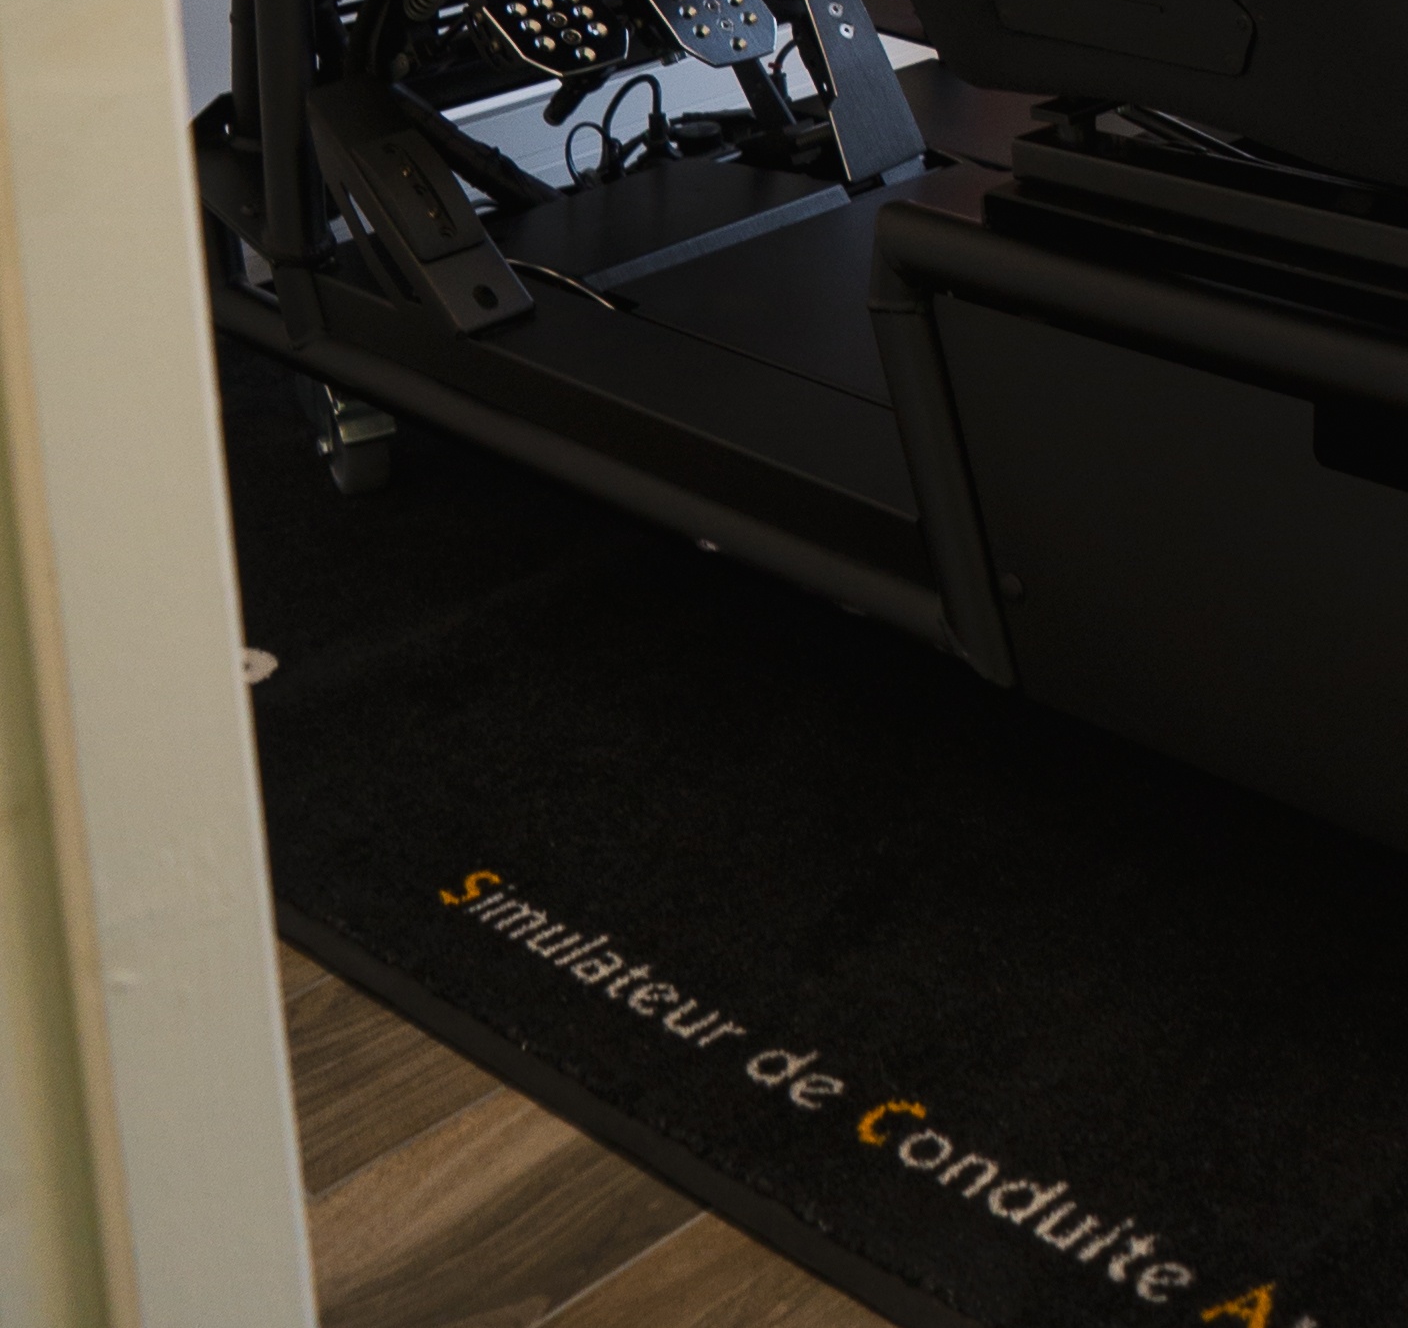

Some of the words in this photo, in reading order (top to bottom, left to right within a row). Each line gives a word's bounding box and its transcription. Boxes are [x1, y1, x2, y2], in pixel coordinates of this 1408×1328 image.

[439, 870, 746, 1049] Simulateur
[746, 1047, 846, 1110] de
[857, 1099, 1195, 1303] Conduite
